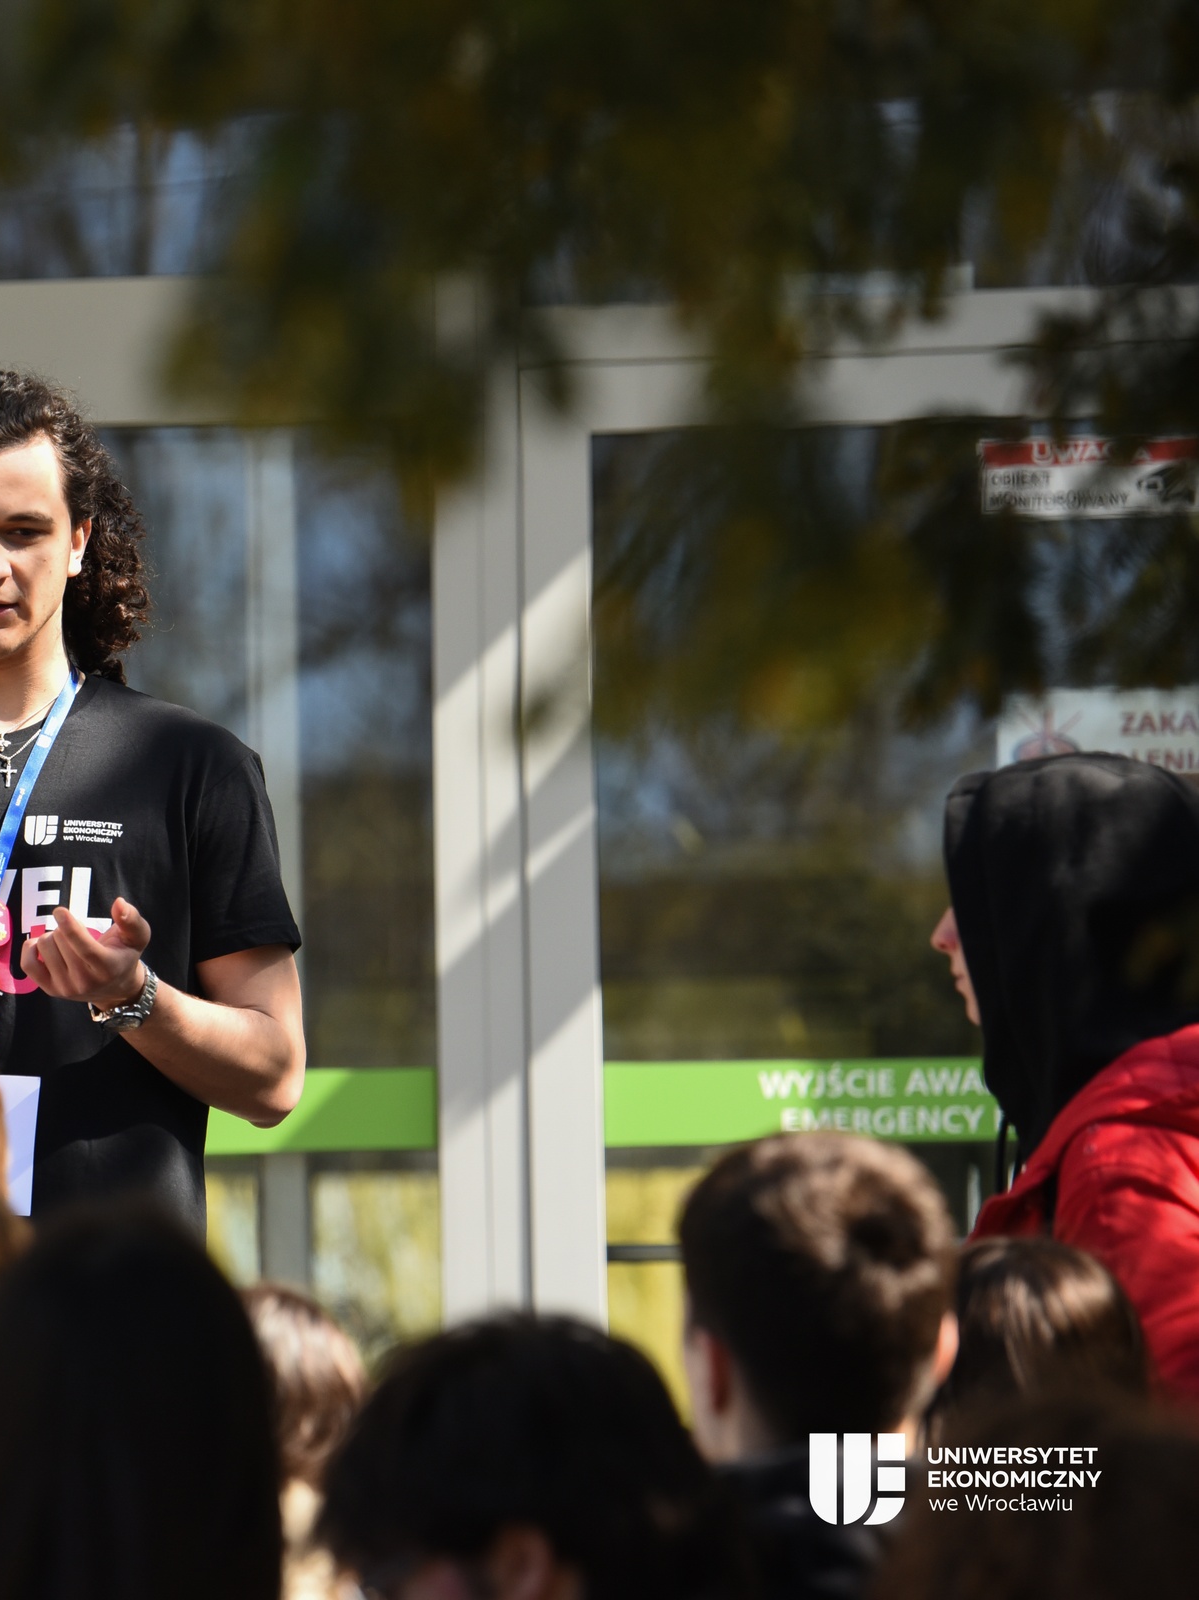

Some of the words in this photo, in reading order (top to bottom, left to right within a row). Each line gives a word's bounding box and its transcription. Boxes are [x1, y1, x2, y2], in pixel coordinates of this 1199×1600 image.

[1031, 439, 1150, 466] UWAA
[63, 819, 123, 830] UNIWERSYTET
[63, 827, 123, 837] EKONOMICZNY
[75, 834, 113, 844] Wrocławiu
[758, 1061, 896, 1099] WYJŚCIE
[905, 1067, 990, 1097] AWA
[780, 1105, 985, 1134] EMERGENCY
